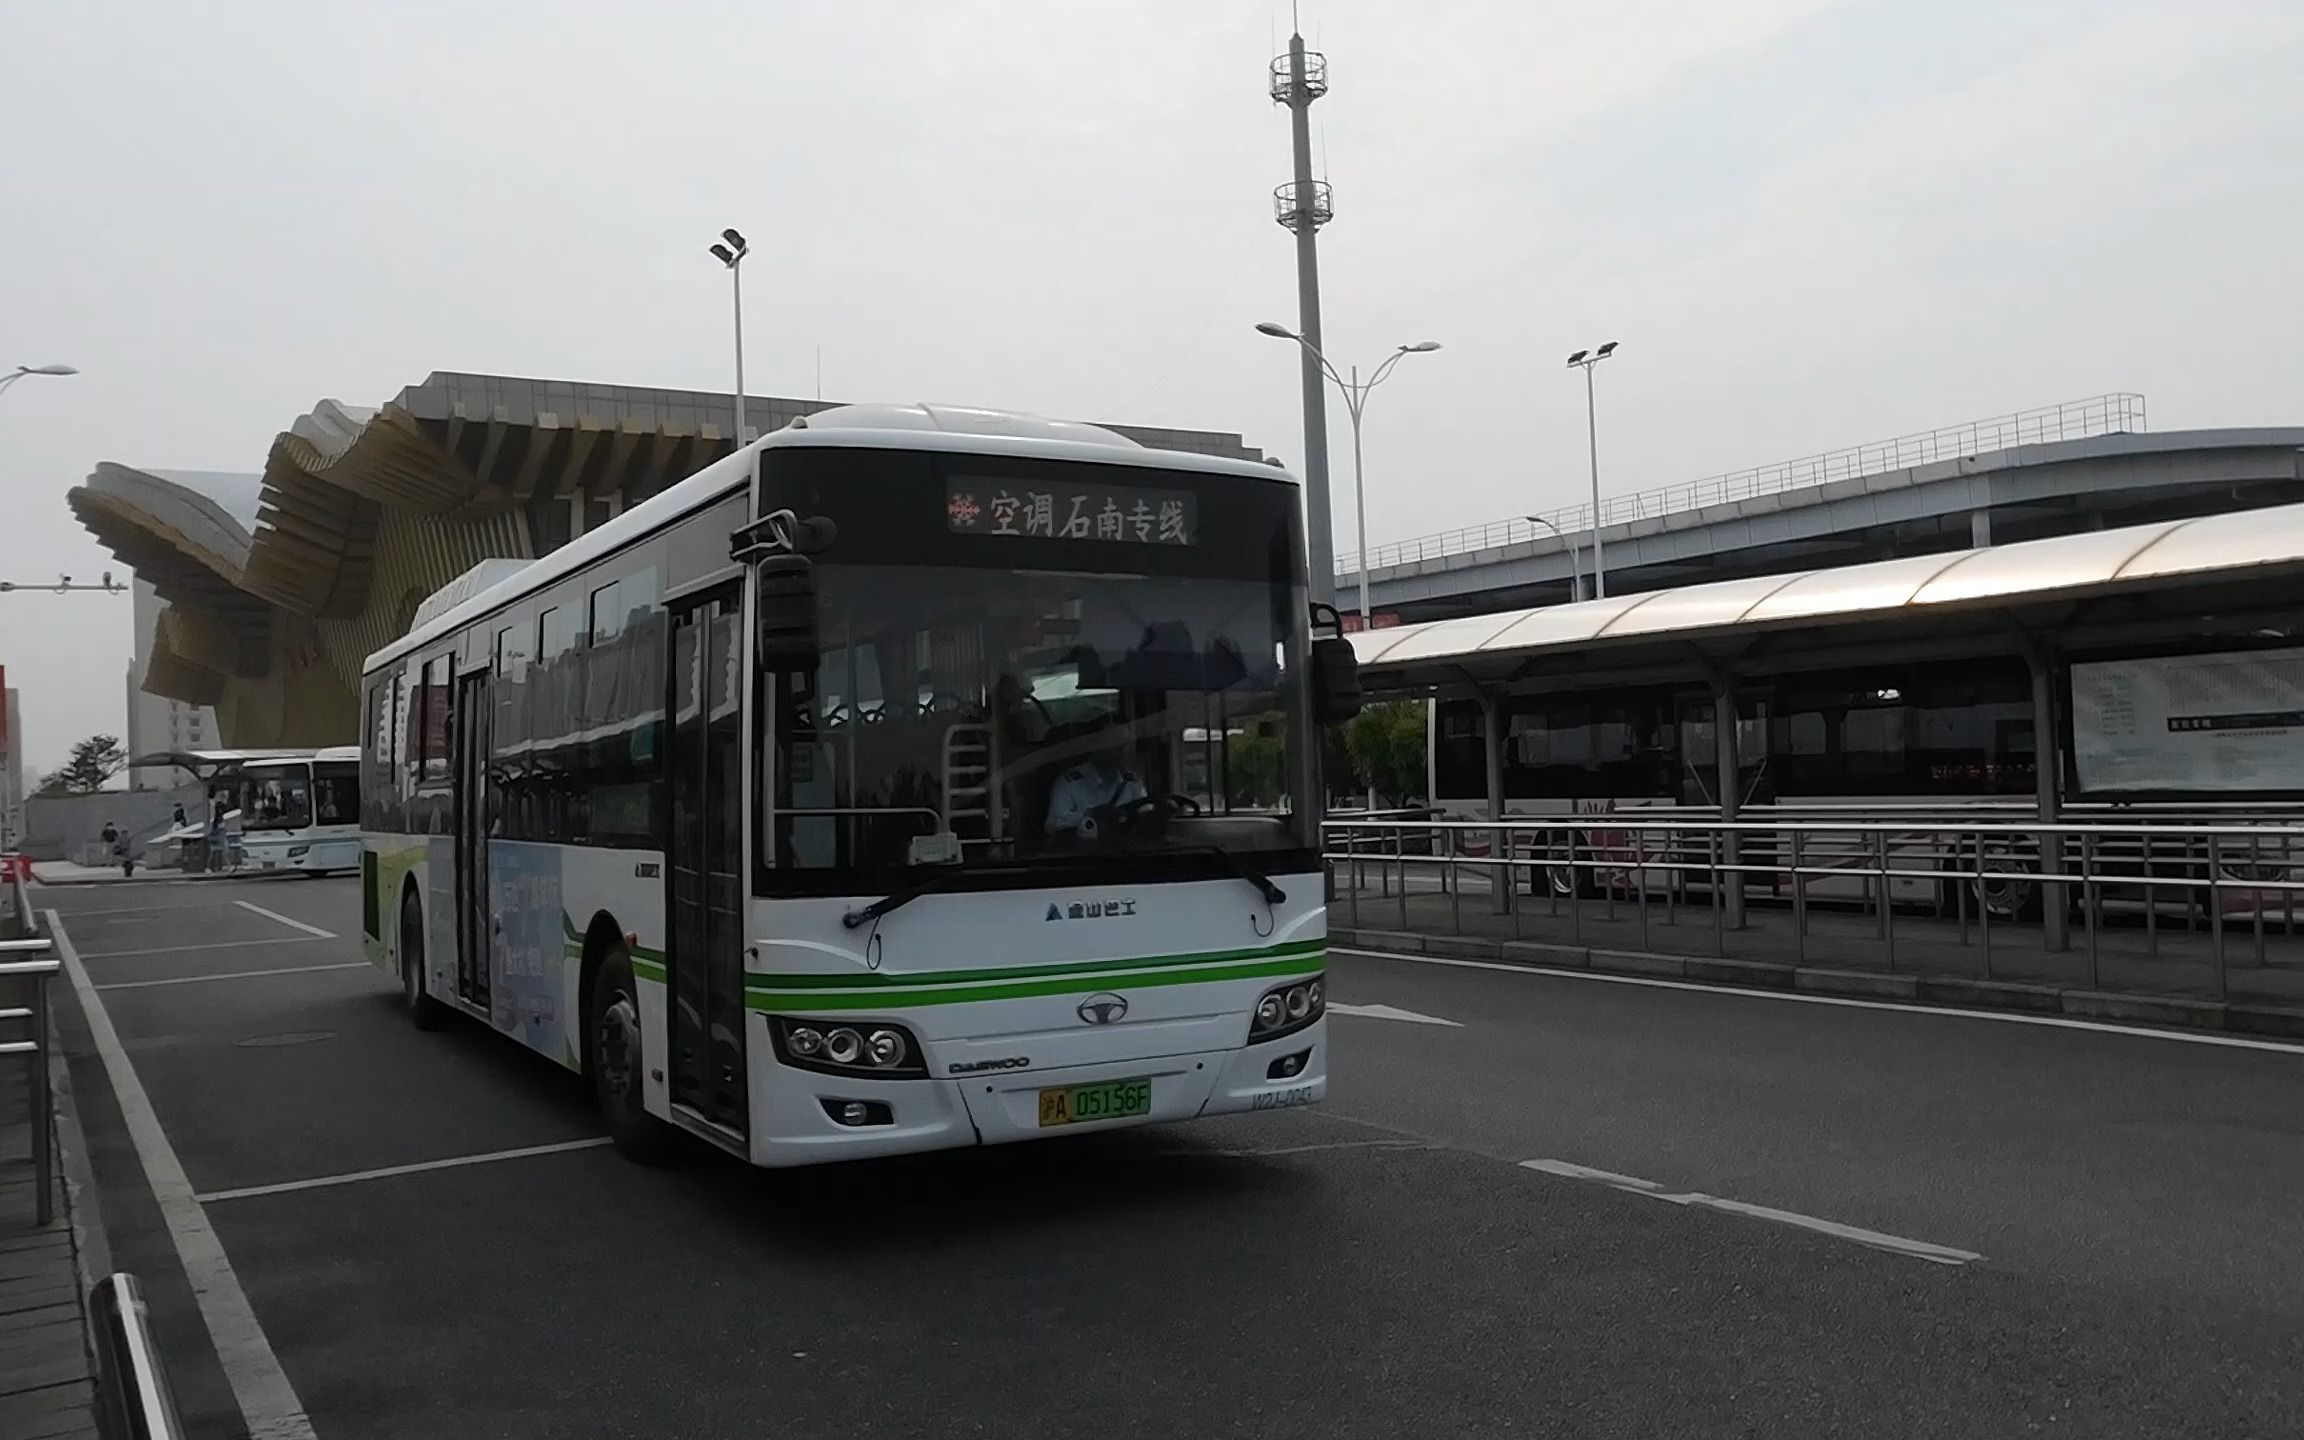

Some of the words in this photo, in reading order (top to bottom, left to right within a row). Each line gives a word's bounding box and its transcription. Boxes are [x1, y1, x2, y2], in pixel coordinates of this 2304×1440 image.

[990, 489, 1188, 545] 空调石南专线
[949, 1057, 1030, 1073] DAEWOO
